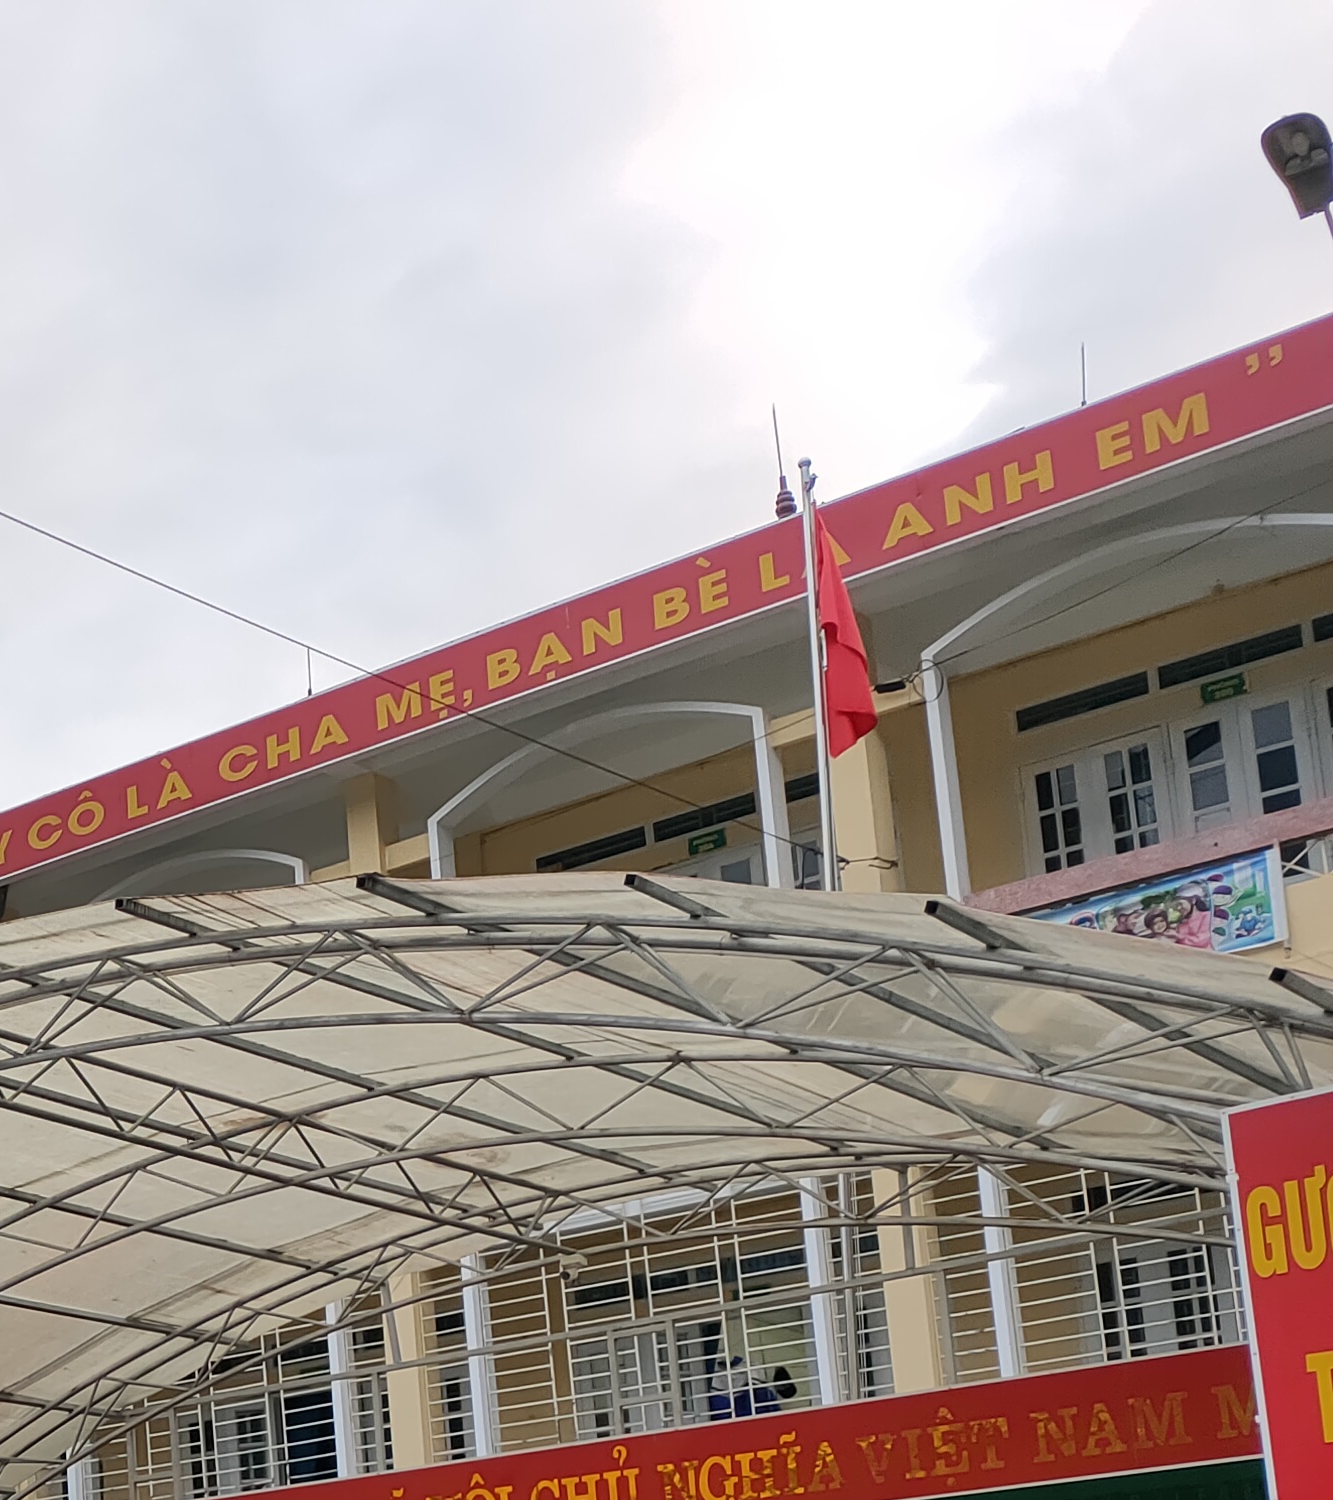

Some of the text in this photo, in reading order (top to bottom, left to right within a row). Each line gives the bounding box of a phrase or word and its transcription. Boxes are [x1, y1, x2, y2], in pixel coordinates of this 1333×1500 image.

[26, 790, 104, 850] CÔ
[125, 758, 193, 819] LÀ
[218, 714, 349, 782] CHA
[485, 607, 623, 691] BẠN
[652, 557, 729, 631] BÈ
[881, 449, 1055, 550] ANH
[1095, 391, 1210, 471] EM
[1245, 1164, 1333, 1279] GƯ
[855, 1407, 1009, 1486] VIỆT
[1029, 1391, 1193, 1464] NAM
